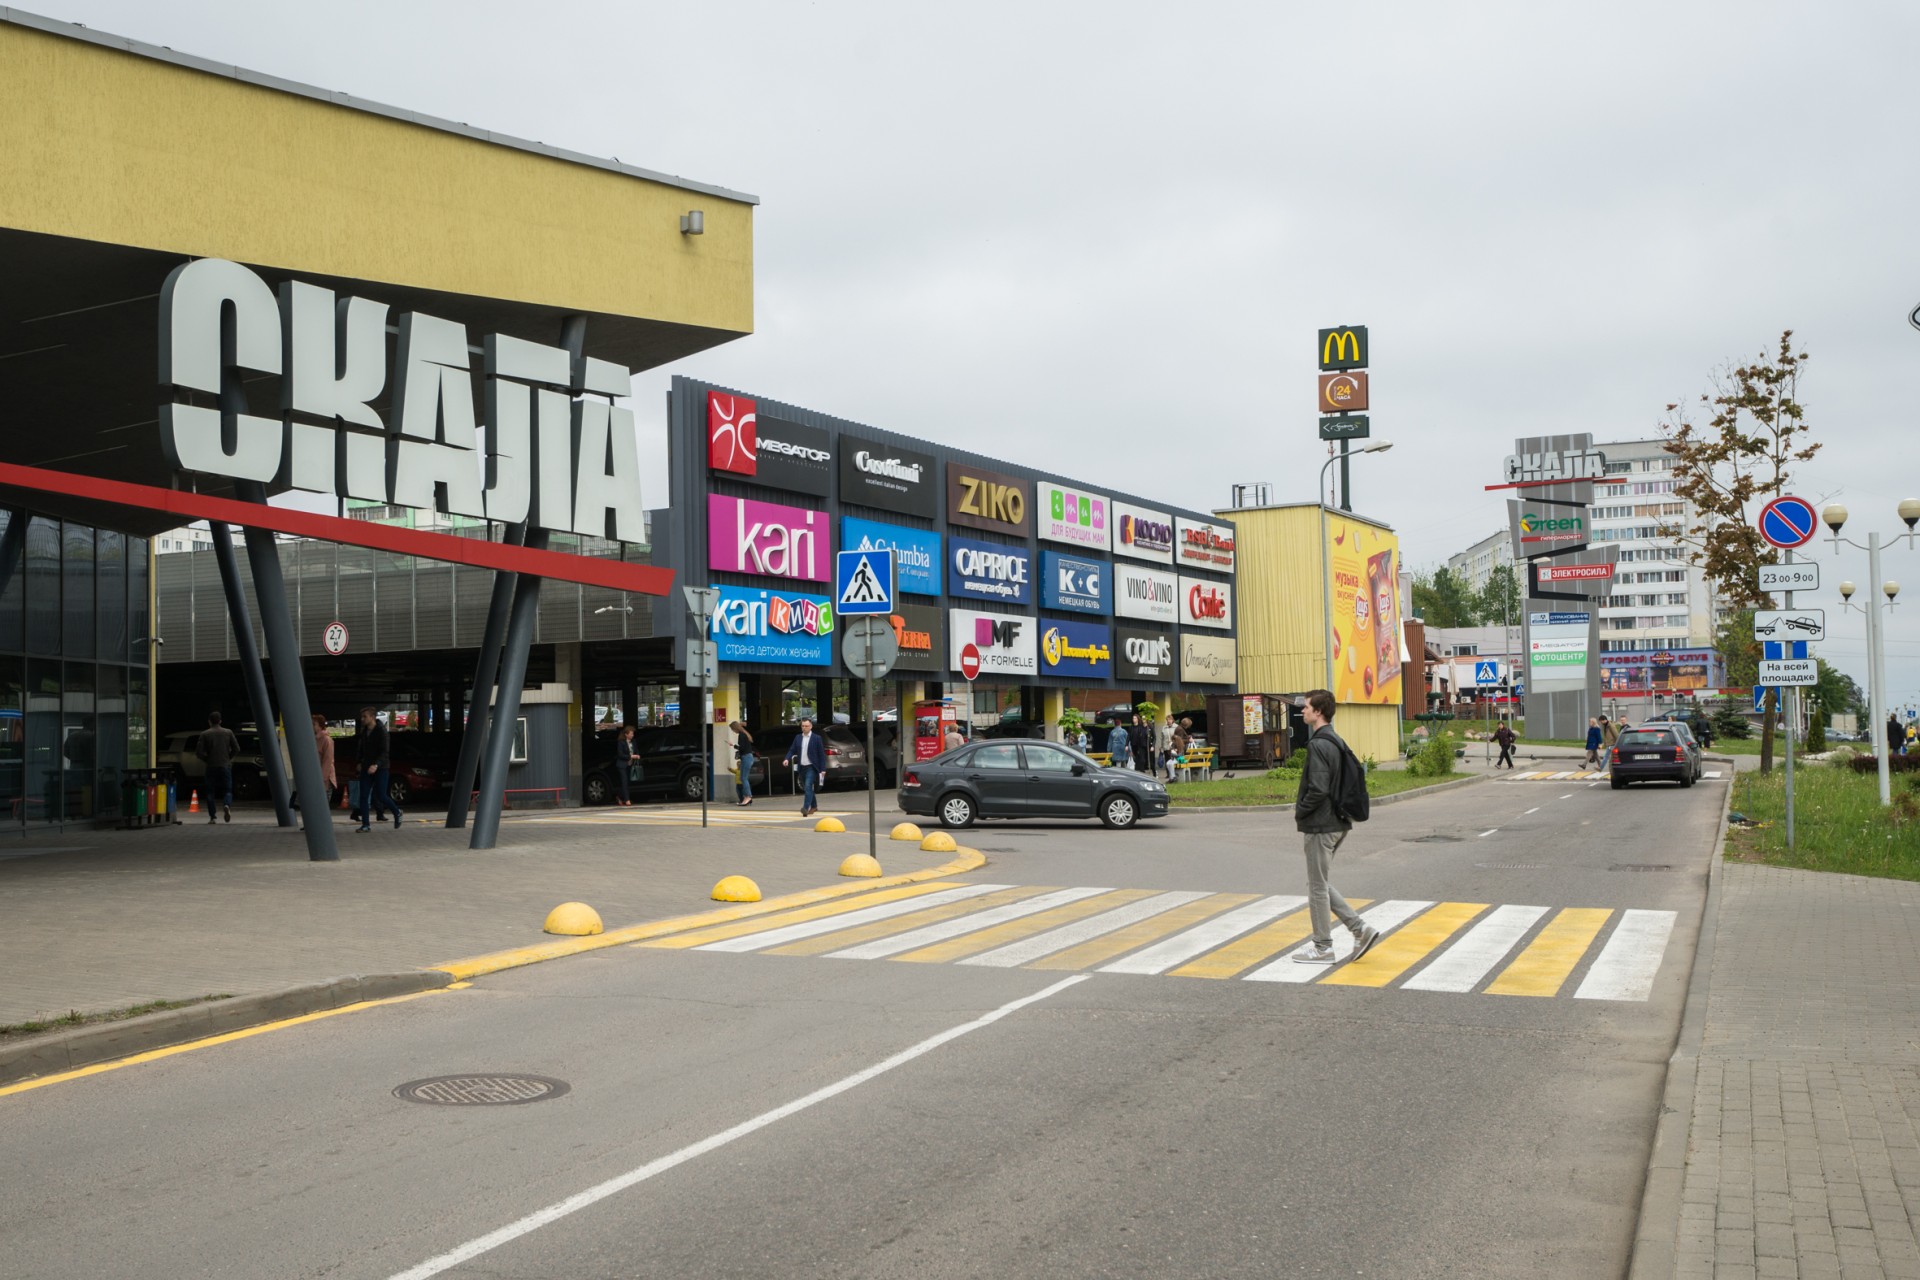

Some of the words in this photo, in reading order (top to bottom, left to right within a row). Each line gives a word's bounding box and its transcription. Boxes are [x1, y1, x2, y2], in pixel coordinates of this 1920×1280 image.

[158, 257, 645, 544] СКАЛА
[1336, 385, 1351, 395] 24
[756, 437, 830, 462] MEGATOP
[1503, 449, 1606, 483] СКАЛА
[958, 475, 1024, 525] ZIKO
[1051, 523, 1064, 537] ДЛЯ
[1064, 526, 1091, 542] БУДУЩИХ
[1092, 531, 1104, 544] МАМ
[1134, 518, 1172, 543] КОСМО
[1520, 514, 1582, 532] Green
[736, 498, 815, 578] kari
[1185, 528, 1207, 545] BSB
[1213, 534, 1234, 551] Bank
[955, 548, 1028, 583] CAPRICE
[1552, 567, 1607, 578] ЭЛЕКТРОСИЛА
[1126, 577, 1172, 604] VINO&VINO
[1335, 572, 1358, 588] музыка
[712, 587, 767, 636] kari
[774, 600, 832, 632] КИДС
[1058, 596, 1084, 607] НЕМЕЦКАЯ
[1084, 600, 1100, 609] ОБУВЬ
[330, 630, 342, 640] 2,7
[991, 619, 1022, 648] MF
[726, 644, 755, 658] страна
[756, 646, 788, 657] детских
[788, 647, 820, 658] желаний
[992, 655, 1034, 668] FORMELLE
[1125, 636, 1171, 666] COLIN'S
[1533, 652, 1584, 662] ФОТОЦЕНТР
[1678, 654, 1708, 662] КЛУБ
[1766, 663, 1781, 671] На
[1784, 662, 1808, 671] всей
[1762, 674, 1815, 683] площадке
